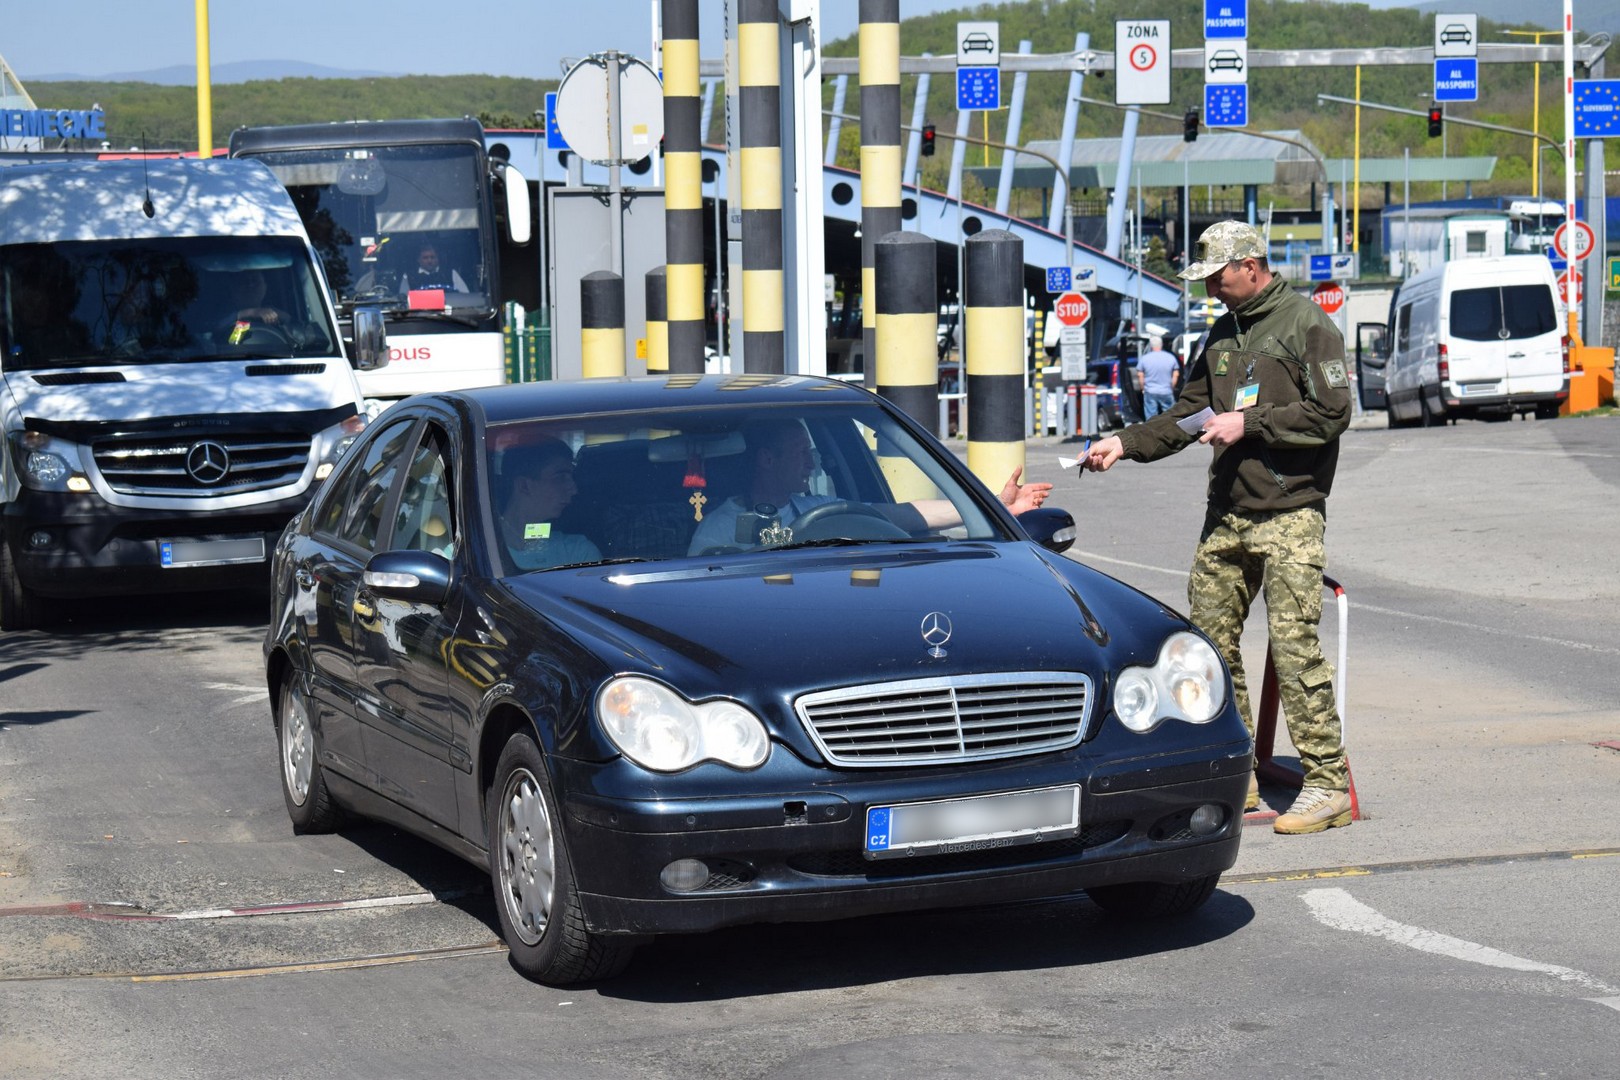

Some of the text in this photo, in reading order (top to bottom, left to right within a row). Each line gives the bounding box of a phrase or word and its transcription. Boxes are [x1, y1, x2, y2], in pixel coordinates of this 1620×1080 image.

[1220, 8, 1232, 16] ALL
[1206, 18, 1245, 27] PASSPORTS
[1140, 51, 1147, 64] 5
[1450, 70, 1462, 78] ALL
[1436, 81, 1475, 89] PASSPORTS
[1313, 291, 1343, 305] STOP
[1058, 302, 1087, 317] STOP
[870, 835, 887, 846] CZ
[938, 838, 1015, 854] Mercedes-Benz
